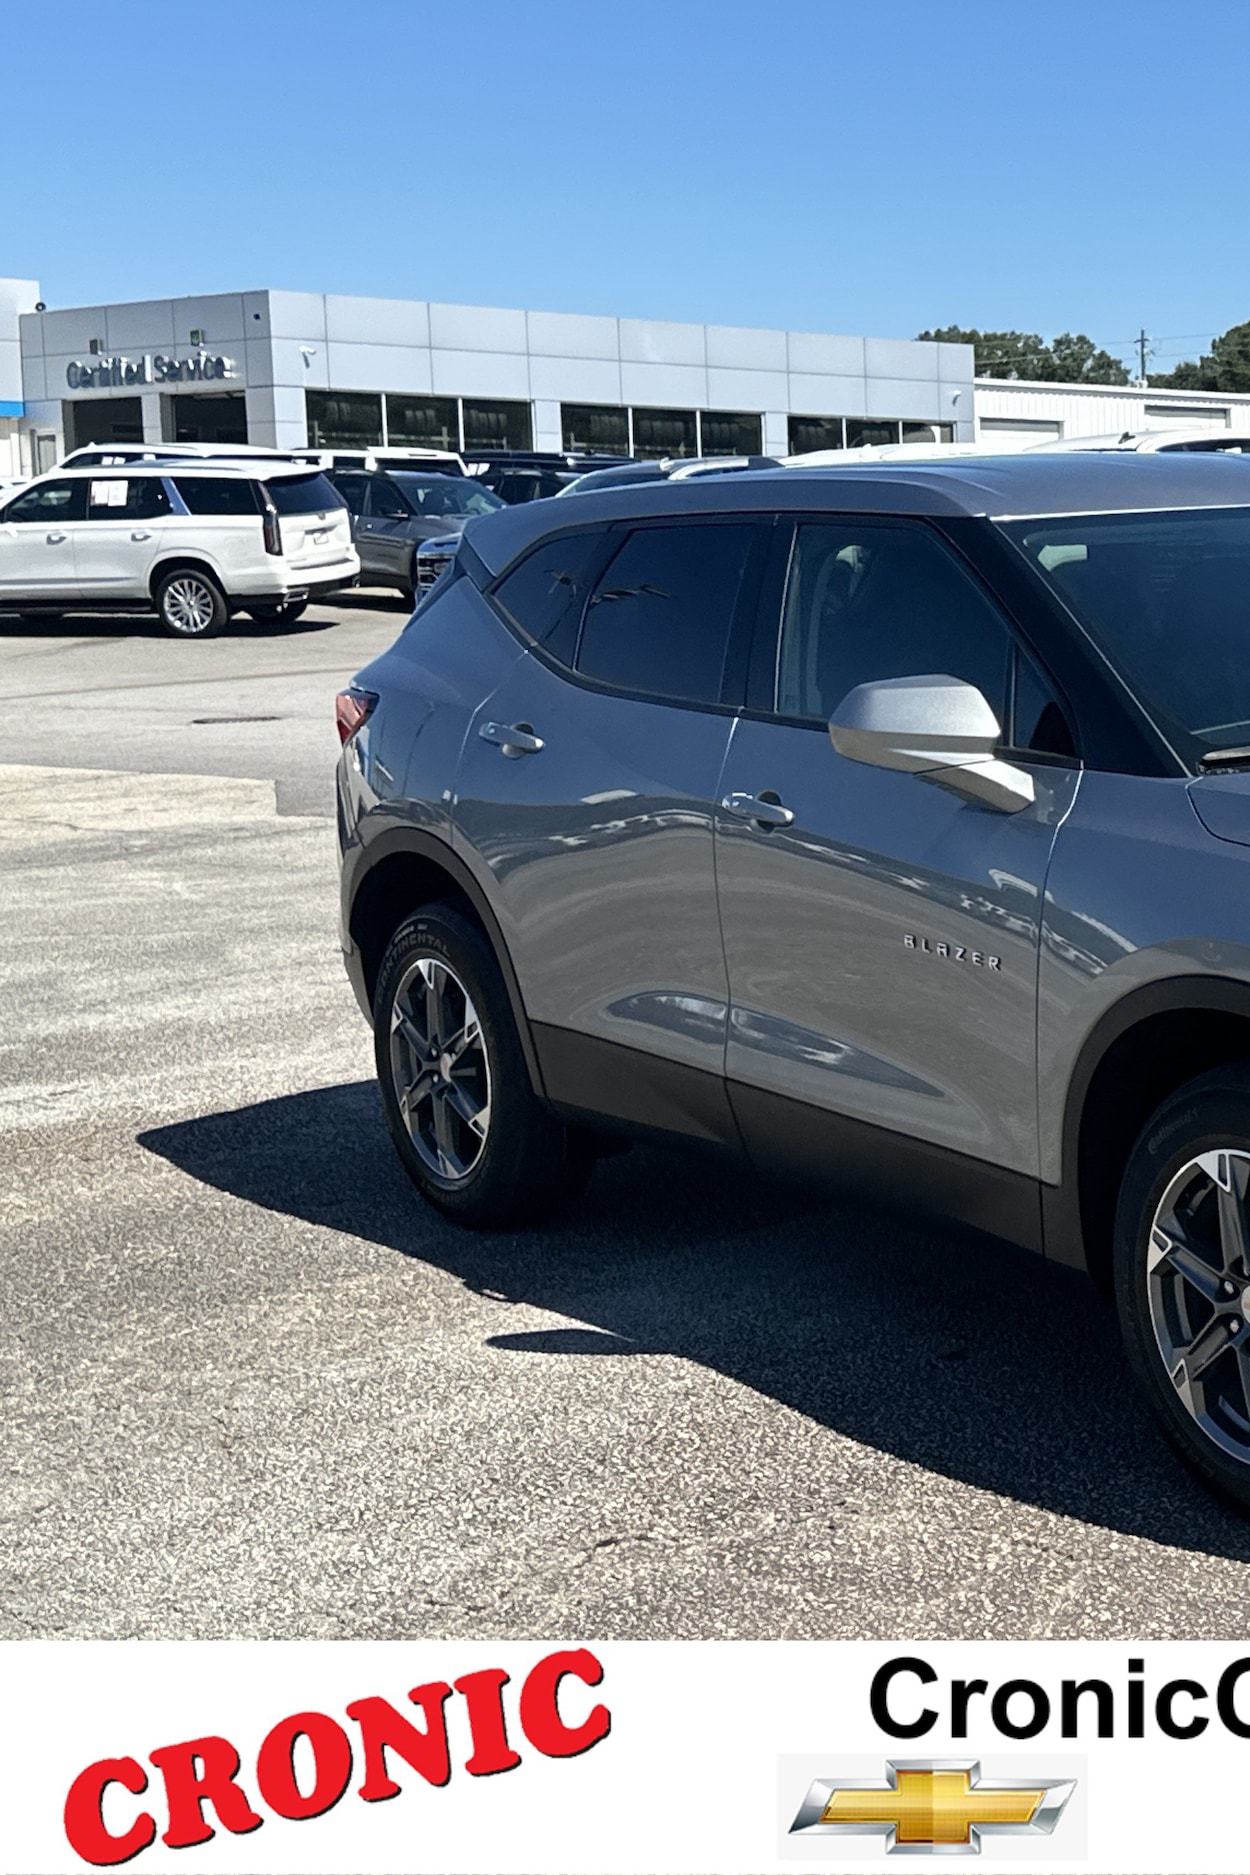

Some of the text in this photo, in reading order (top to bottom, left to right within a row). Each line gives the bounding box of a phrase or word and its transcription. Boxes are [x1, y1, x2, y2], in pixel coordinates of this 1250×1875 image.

[66, 350, 234, 390] Certified Service
[903, 933, 1002, 972] BLAZER
